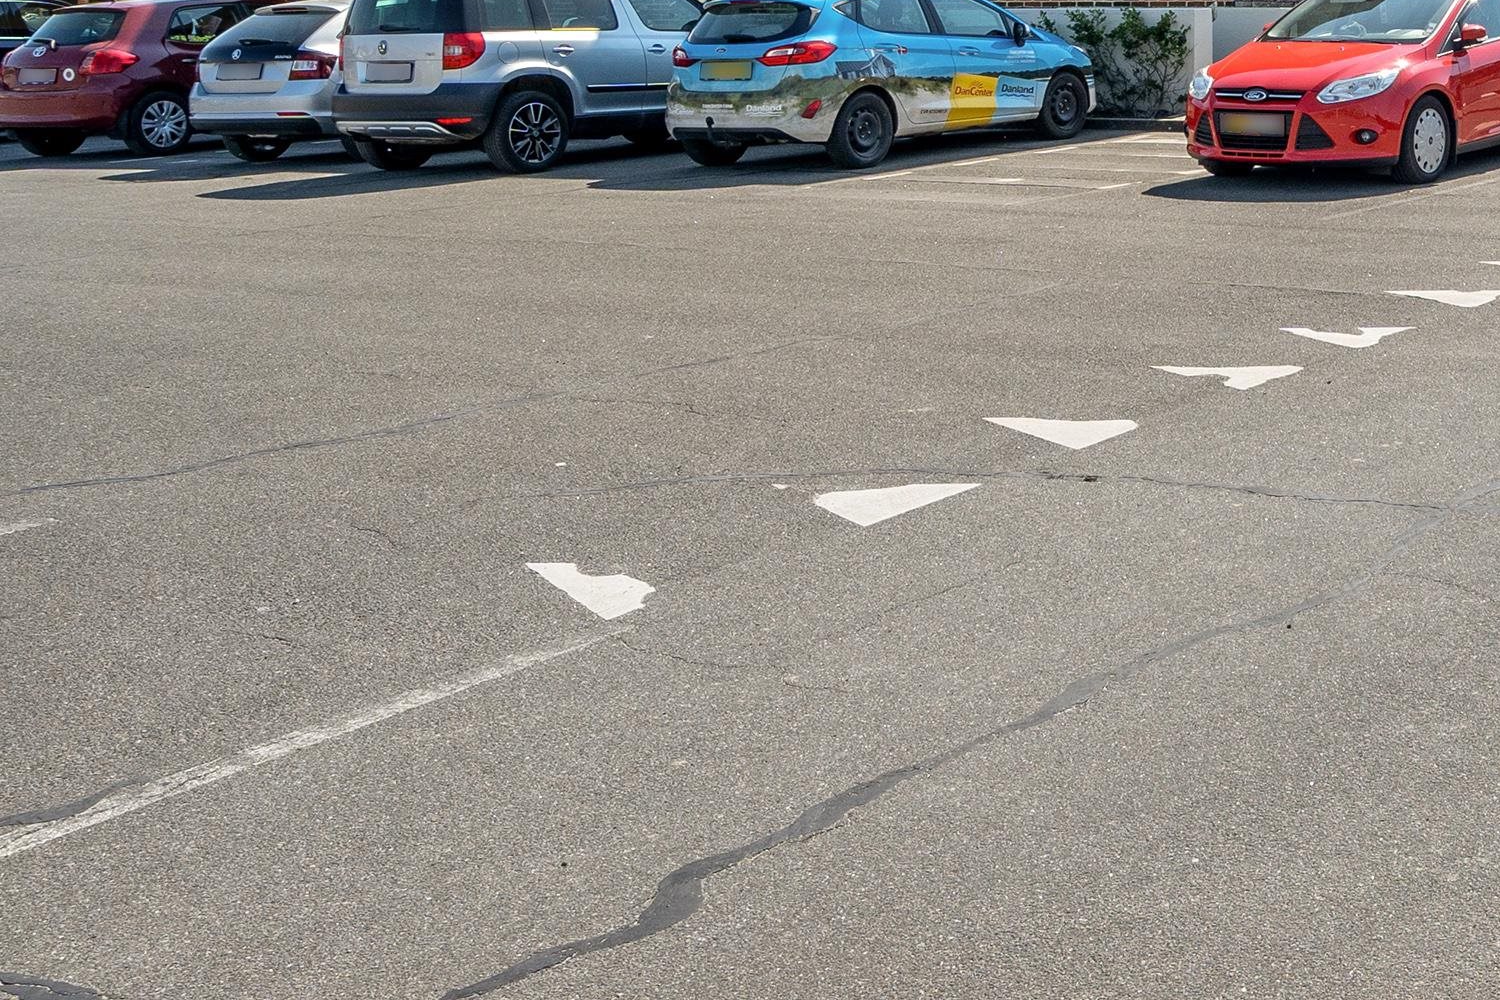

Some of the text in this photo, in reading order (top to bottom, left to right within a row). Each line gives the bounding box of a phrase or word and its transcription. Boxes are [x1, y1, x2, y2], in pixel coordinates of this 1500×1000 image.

[954, 85, 994, 97] DanCenter
[1001, 83, 1034, 94] Danland
[746, 104, 782, 112] Danland
